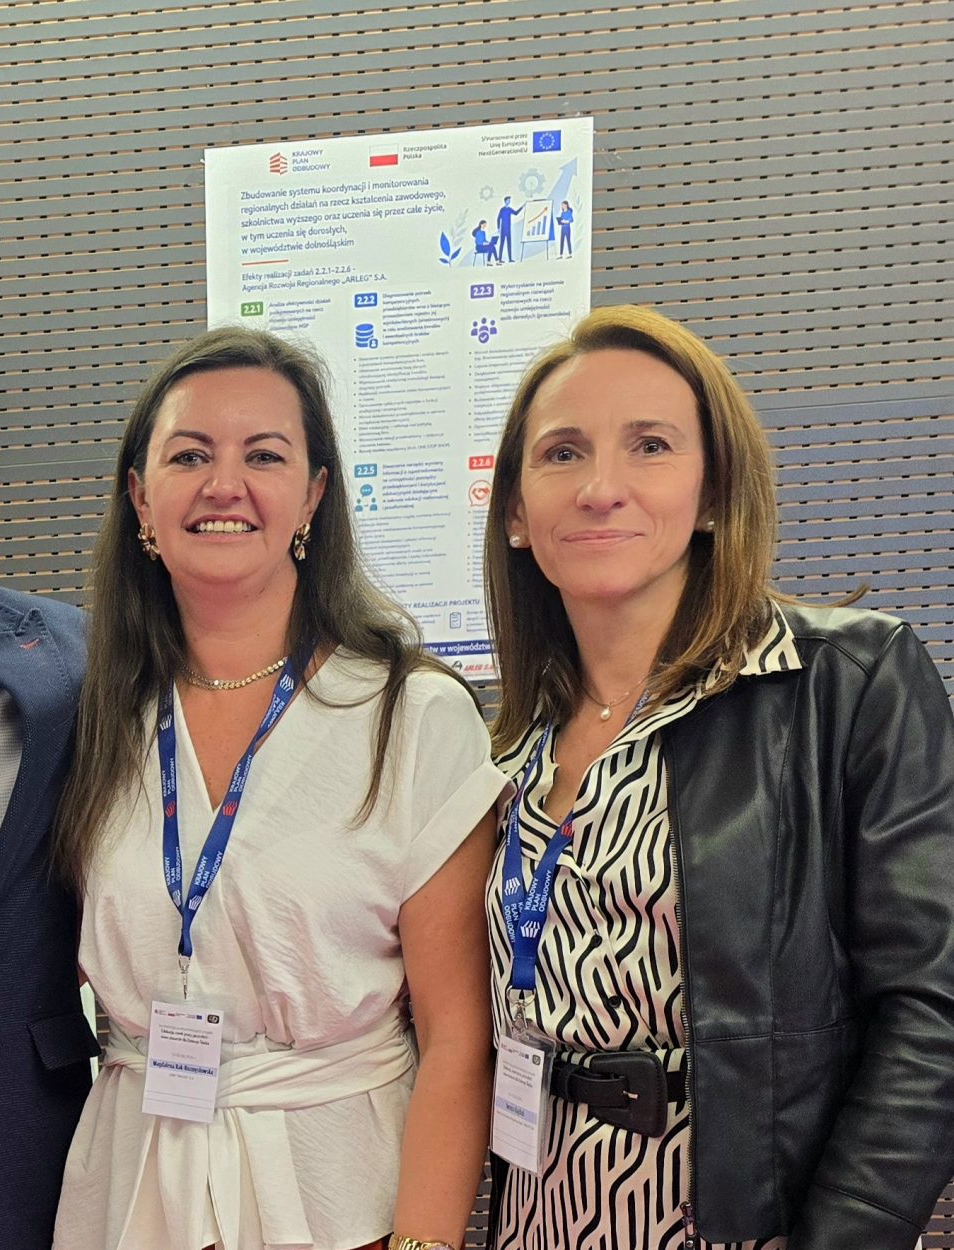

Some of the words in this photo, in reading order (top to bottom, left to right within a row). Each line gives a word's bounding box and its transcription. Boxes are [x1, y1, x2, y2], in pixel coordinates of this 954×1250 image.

[403, 143, 447, 154] Rzeczpospolita
[241, 189, 287, 200] Zbudowanie
[288, 187, 321, 198] systemu
[322, 182, 366, 194] koordynacji
[372, 178, 429, 190] monitorowania
[241, 203, 289, 215] regionalnych
[290, 200, 317, 210] działań
[351, 194, 393, 205] kształcenia
[395, 191, 446, 202] zawodowego,
[241, 217, 285, 228] szkolnictwa
[286, 214, 322, 226] wyższego
[324, 213, 340, 221] oraz
[342, 210, 371, 219] uczenia
[372, 209, 383, 218] się
[384, 208, 405, 217] przez
[406, 205, 422, 214] całe
[424, 204, 445, 214] życie,
[249, 233, 265, 242] tym
[266, 230, 294, 238] uczenia
[296, 228, 307, 238] się
[308, 225, 348, 237] dorosłych,
[250, 243, 303, 255] województwie
[304, 239, 354, 250] dolnośląskim
[242, 273, 263, 282] Efekty
[264, 270, 292, 280] realizacji
[294, 268, 314, 277] zadań
[242, 283, 267, 293] Agencja
[269, 281, 295, 290] Rozwoju
[297, 277, 340, 289] Regionalnego
[473, 287, 492, 296] 2.2.3
[413, 601, 448, 609] REALIZACJI
[449, 599, 480, 607] PROJEKTU
[234, 776, 243, 793] PLAN
[194, 856, 209, 886] KRAJOWY
[201, 871, 211, 889] PLAN
[524, 878, 539, 911] KRAJOWY
[538, 869, 552, 913] ODBUDOWY
[531, 893, 541, 912] PLAN
[510, 903, 519, 921] PLAN
